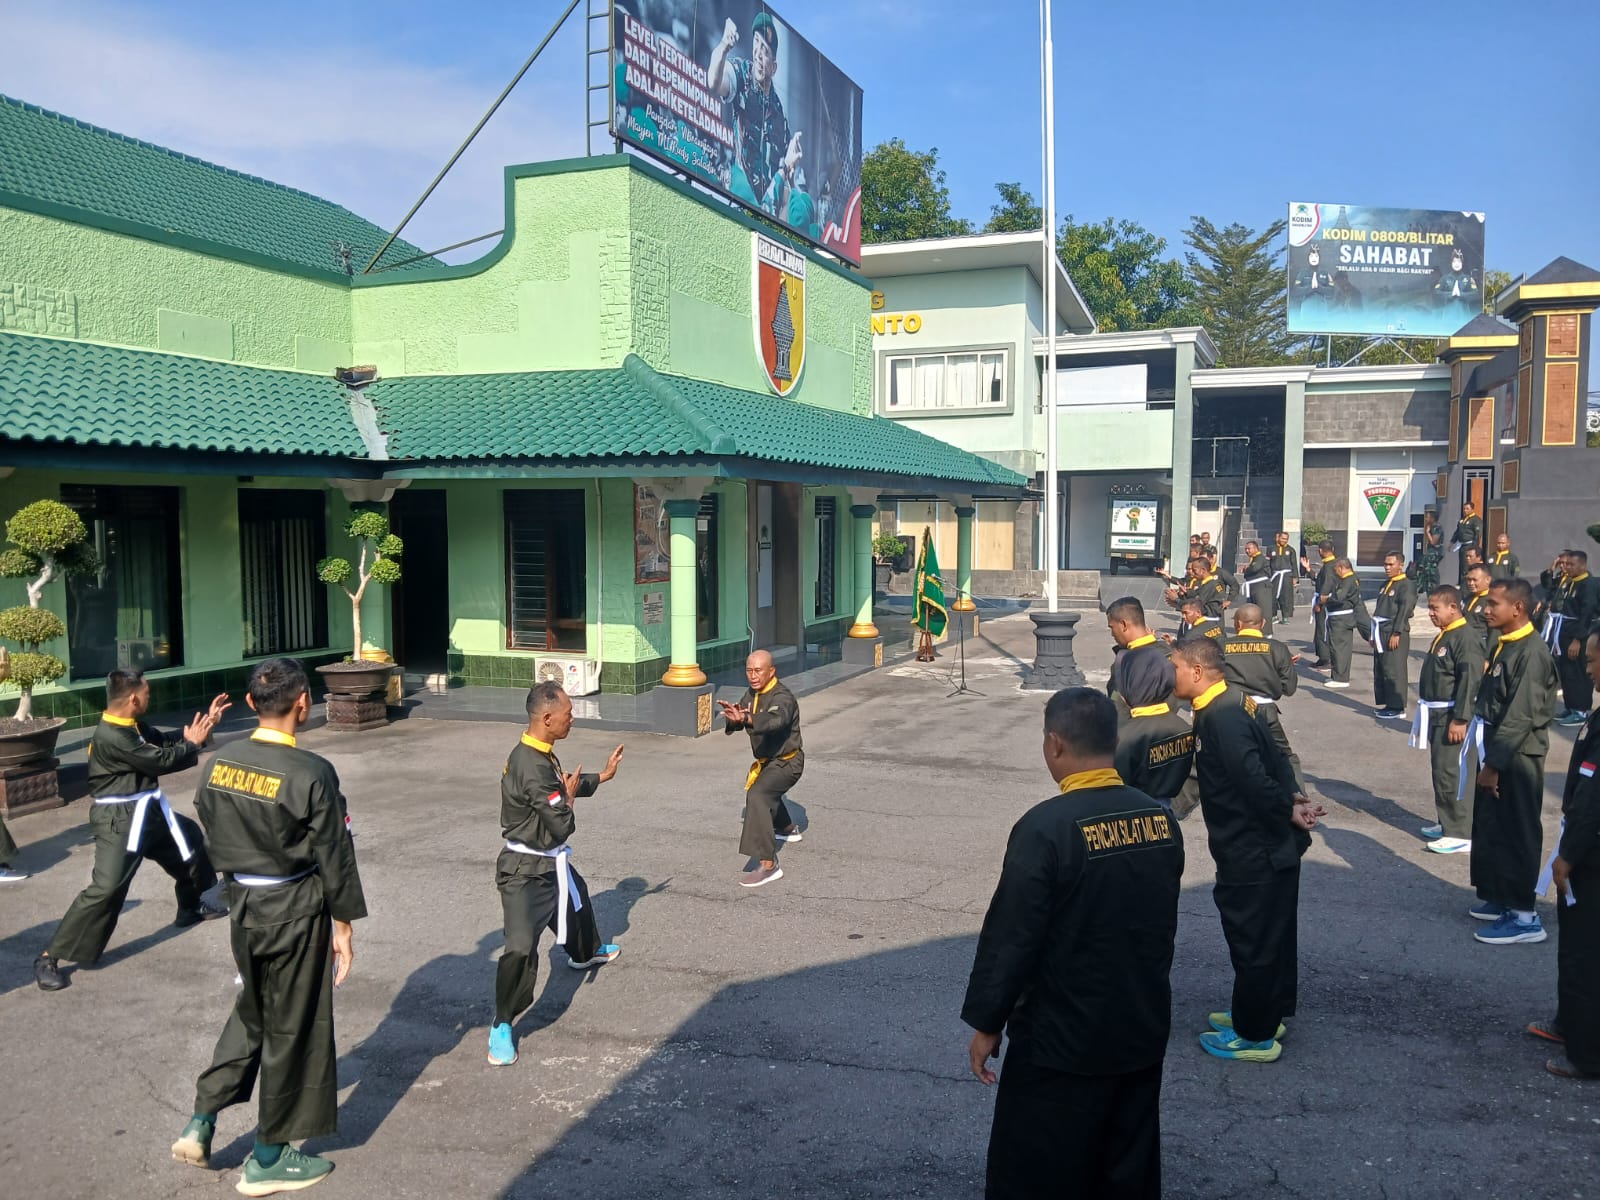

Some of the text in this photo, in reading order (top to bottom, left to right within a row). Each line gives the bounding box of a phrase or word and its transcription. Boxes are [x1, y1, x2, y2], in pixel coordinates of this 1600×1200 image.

[624, 15, 707, 87] LEVEL TERTINGGI
[624, 38, 722, 119] DARI KEPEMIMPINAN
[625, 65, 735, 148] ADALAH KETELADANAN
[627, 115, 654, 141] Mayjen
[1322, 228, 1454, 246] KODIM 0808/BLITAR
[1340, 244, 1432, 267] SAHABAT
[1083, 821, 1121, 852] PENCAK
